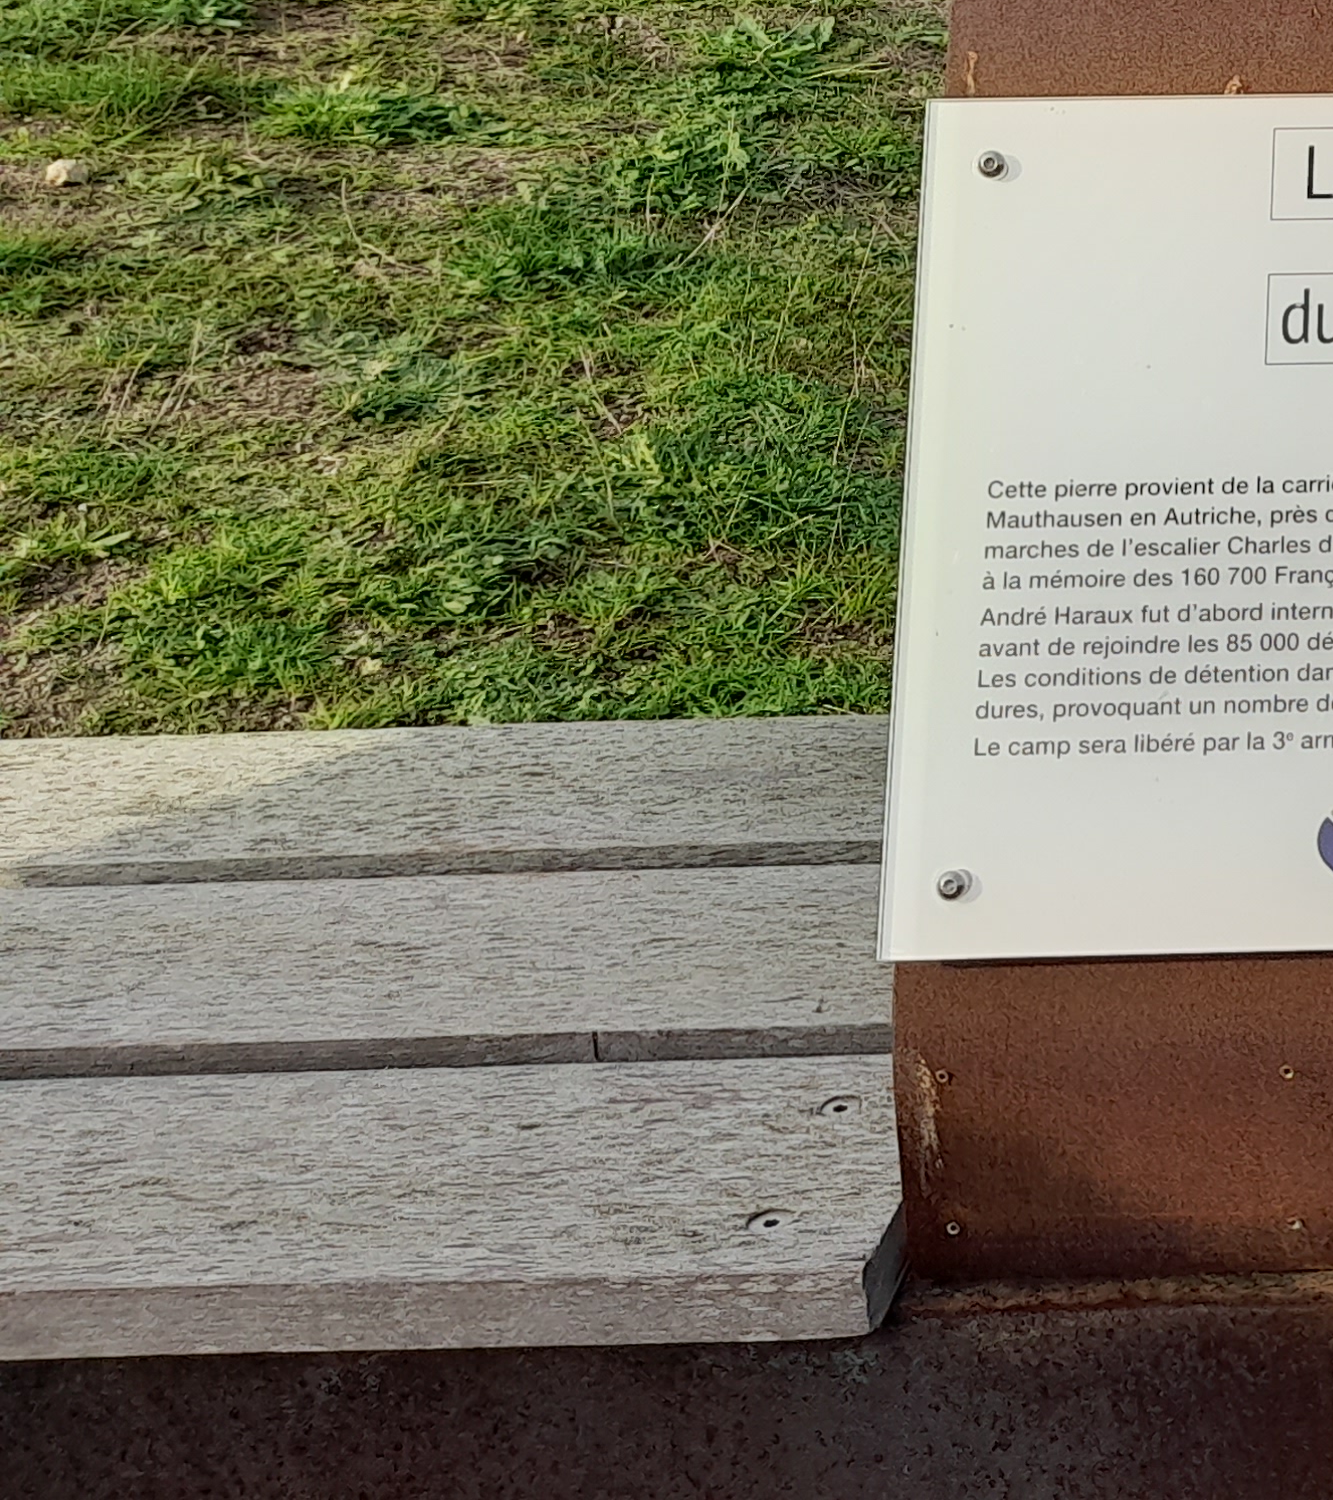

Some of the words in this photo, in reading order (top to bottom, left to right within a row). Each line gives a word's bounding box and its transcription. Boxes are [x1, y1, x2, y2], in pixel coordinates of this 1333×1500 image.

[987, 479, 1048, 500] Cette
[1054, 478, 1118, 503] pierre
[1124, 476, 1215, 501] provient
[1221, 475, 1250, 496] de
[1256, 475, 1275, 495] la
[986, 509, 1123, 530] Mauthausen
[1129, 511, 1157, 527] en
[1162, 505, 1262, 528] Autriche,
[1269, 504, 1318, 529] près
[984, 539, 1080, 560] marches
[1086, 538, 1115, 558] de
[1227, 535, 1312, 556] Charles
[981, 570, 996, 591] à
[1002, 570, 1022, 590] la
[1028, 568, 1127, 590] mémoire
[1132, 567, 1174, 588] des
[1181, 566, 1221, 587] 160
[1227, 565, 1267, 586] 700
[979, 605, 1048, 627] André
[1054, 605, 1134, 626] Haraux
[1140, 604, 1171, 624] fut
[978, 638, 1041, 658] avant
[1047, 636, 1076, 657] de
[1082, 634, 1181, 660] rejoindre
[1187, 634, 1219, 654] les
[1226, 633, 1253, 653] 85
[1259, 631, 1300, 652] 000
[977, 669, 1017, 689] Les
[1023, 666, 1142, 688] conditions
[1148, 665, 1177, 685] de
[1184, 663, 1290, 685] détention
[975, 700, 1045, 722] dures,
[1052, 696, 1183, 723] provoquant
[1188, 699, 1216, 716] un
[1223, 693, 1309, 715] nombre
[973, 737, 1001, 757] Le
[1007, 739, 1071, 760] camp
[1078, 738, 1127, 755] sera
[1134, 732, 1196, 753] libéré
[1202, 736, 1241, 757] par
[1246, 731, 1266, 751] la
